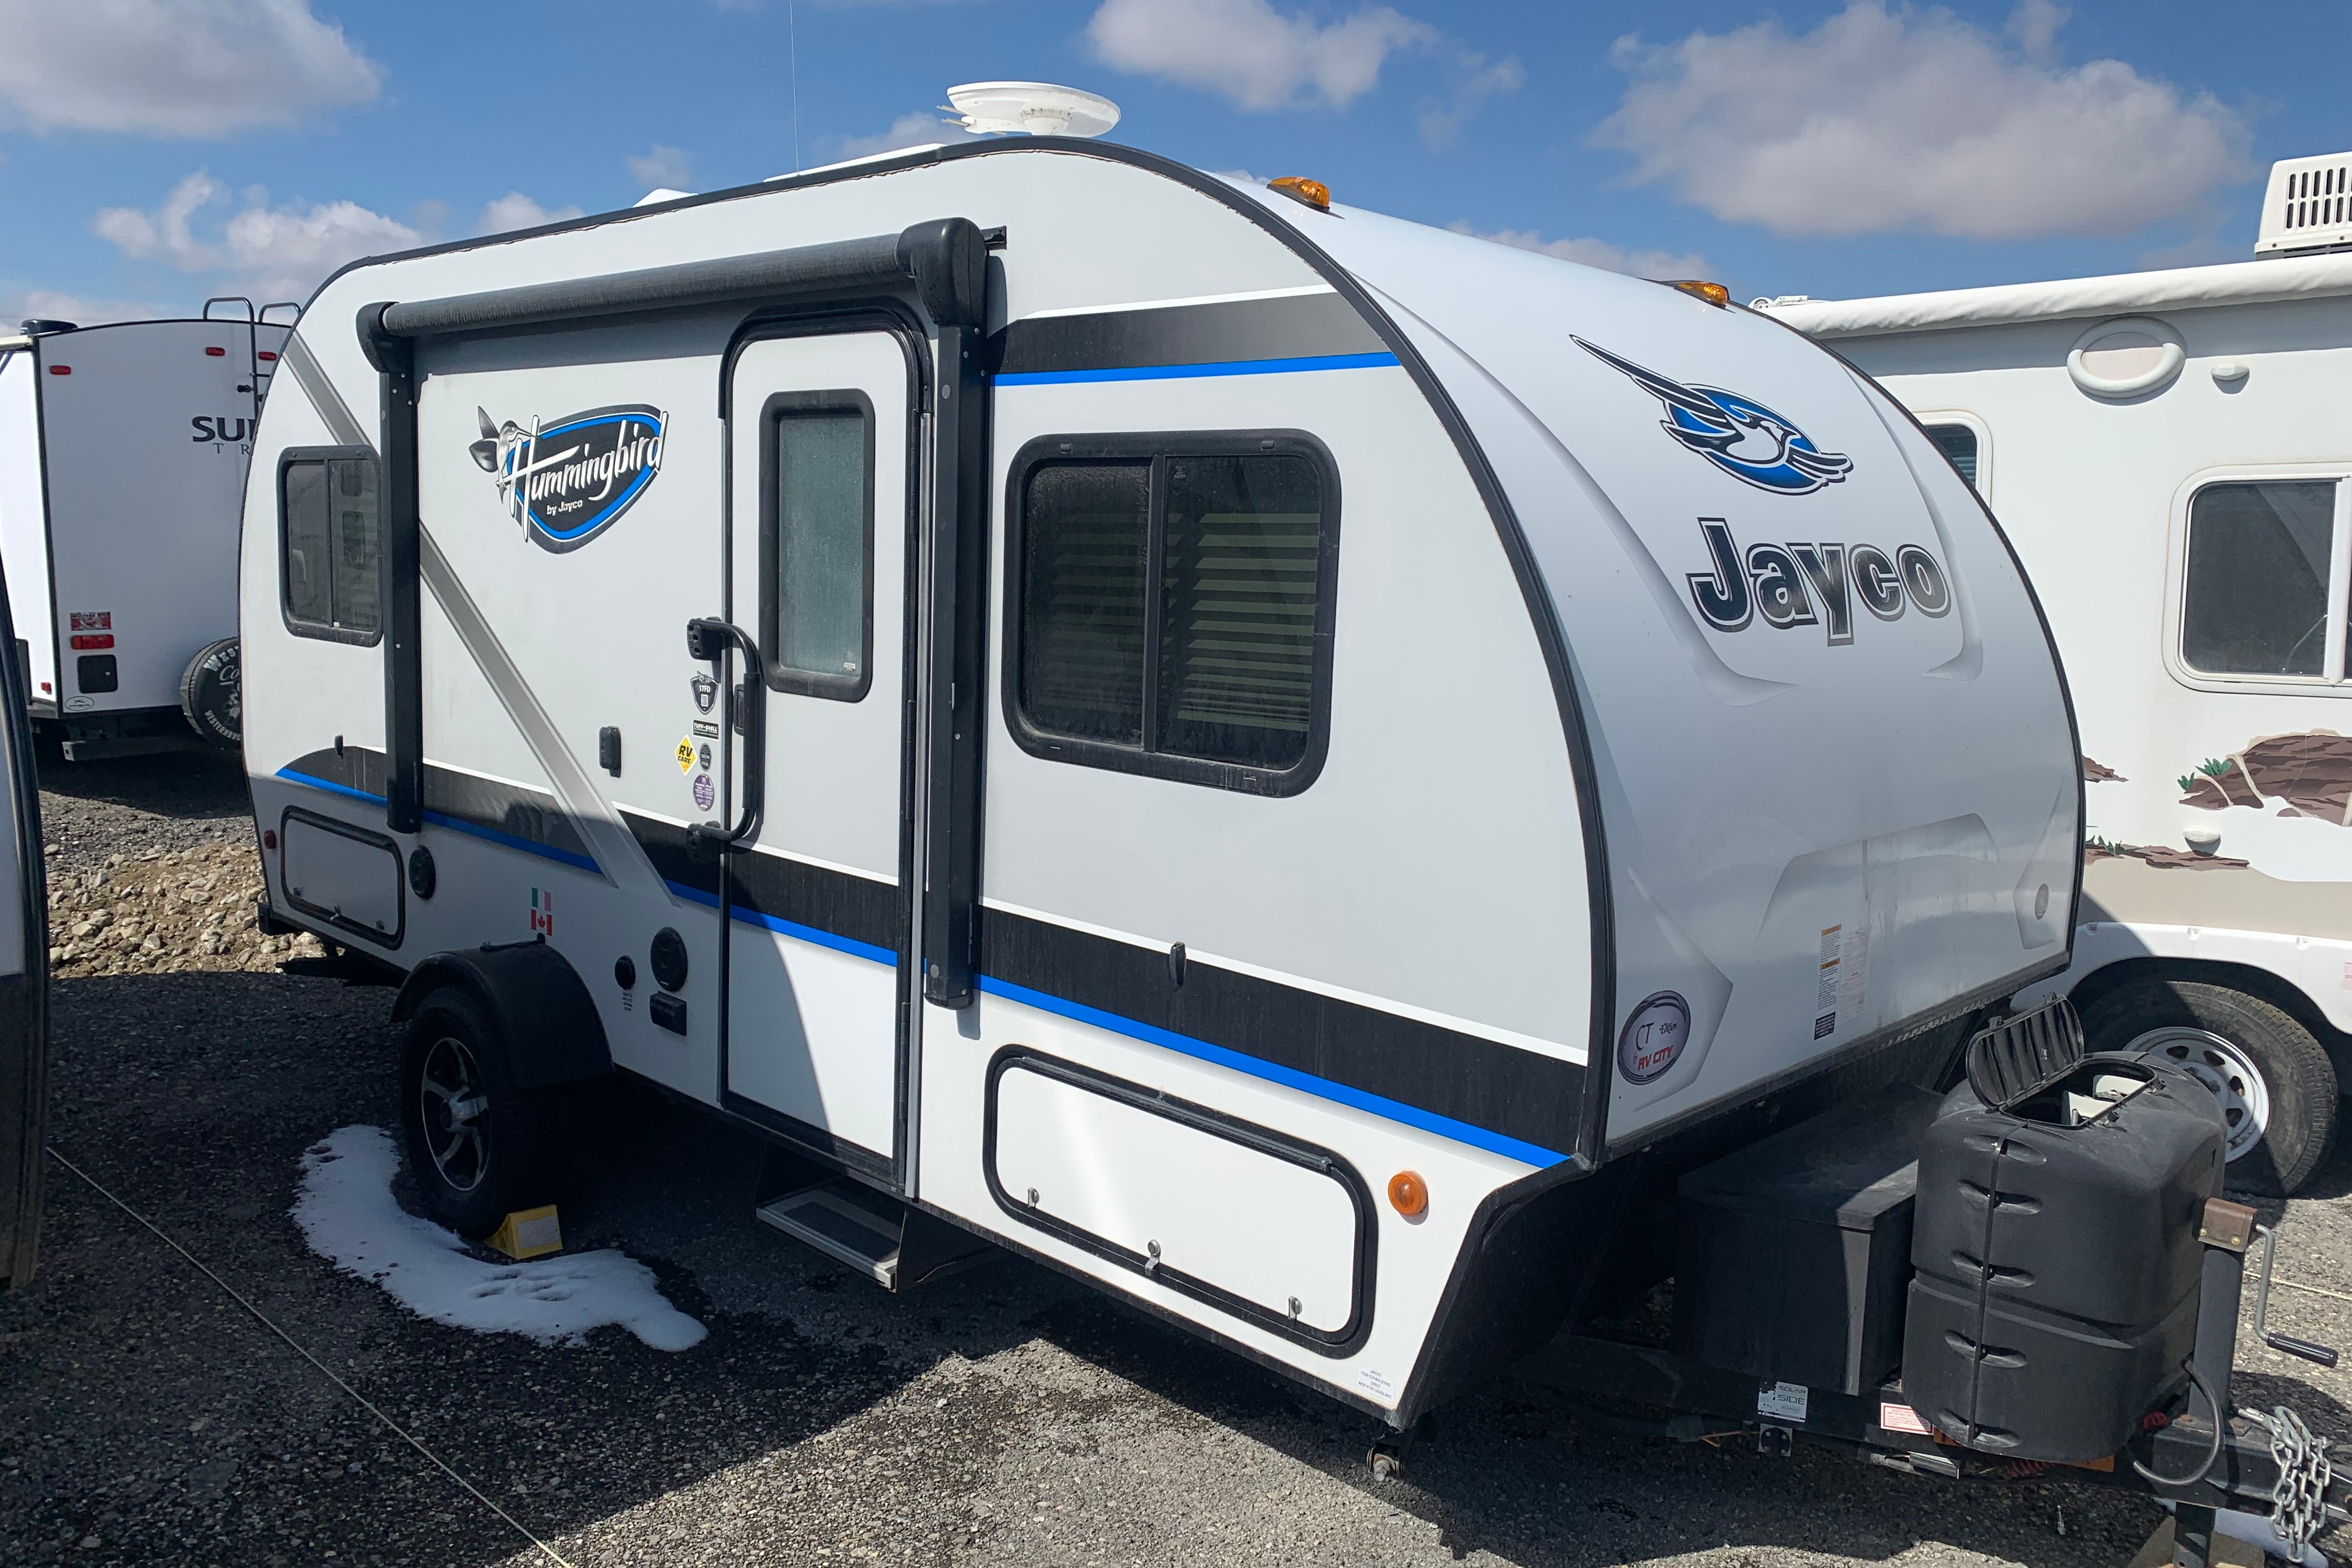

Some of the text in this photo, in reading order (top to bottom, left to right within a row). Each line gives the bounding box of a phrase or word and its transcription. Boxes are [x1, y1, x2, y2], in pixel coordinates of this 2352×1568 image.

[495, 411, 669, 543] Hummingbird
[546, 499, 583, 516] by Jayco
[1685, 517, 1952, 647] Jayco
[699, 685, 711, 693] 17FD
[678, 744, 693, 758] RV
[677, 755, 691, 764] CARE
[1636, 1021, 1655, 1051] CT
[1638, 1053, 1652, 1071] RV
[1653, 1044, 1674, 1065] CITY
[1370, 1369, 1381, 1377] JACKS
[1779, 1385, 1807, 1395] SOLAR
[1777, 1394, 1805, 1405] SIDE
